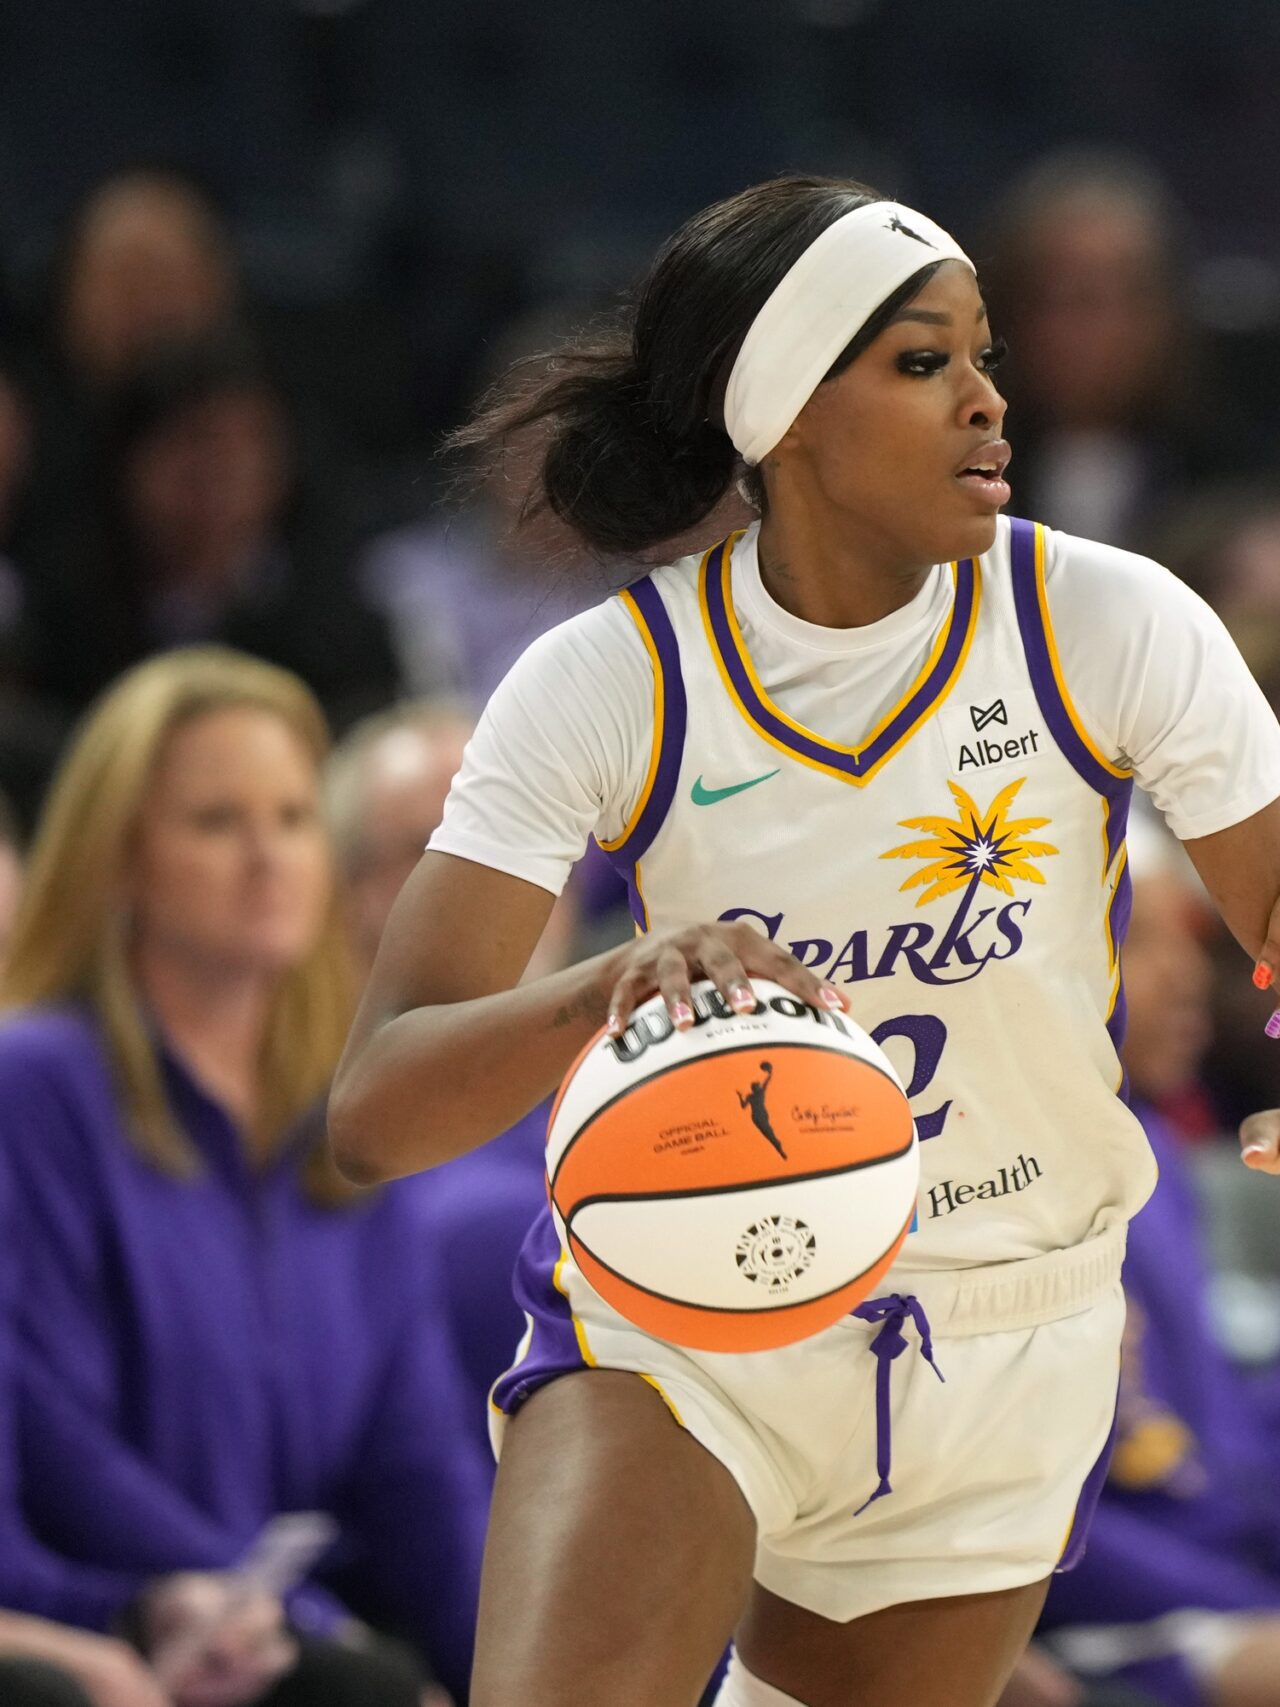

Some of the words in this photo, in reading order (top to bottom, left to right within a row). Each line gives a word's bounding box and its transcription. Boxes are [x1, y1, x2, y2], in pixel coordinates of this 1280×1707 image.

[958, 728, 1039, 772] Albert
[604, 989, 854, 1063] Wlon
[868, 1014, 954, 1142] 2
[653, 1133, 693, 1154] GAME
[695, 1128, 729, 1144] BALL
[659, 1118, 719, 1140] OFFICIAL
[927, 1153, 1043, 1220] Health
